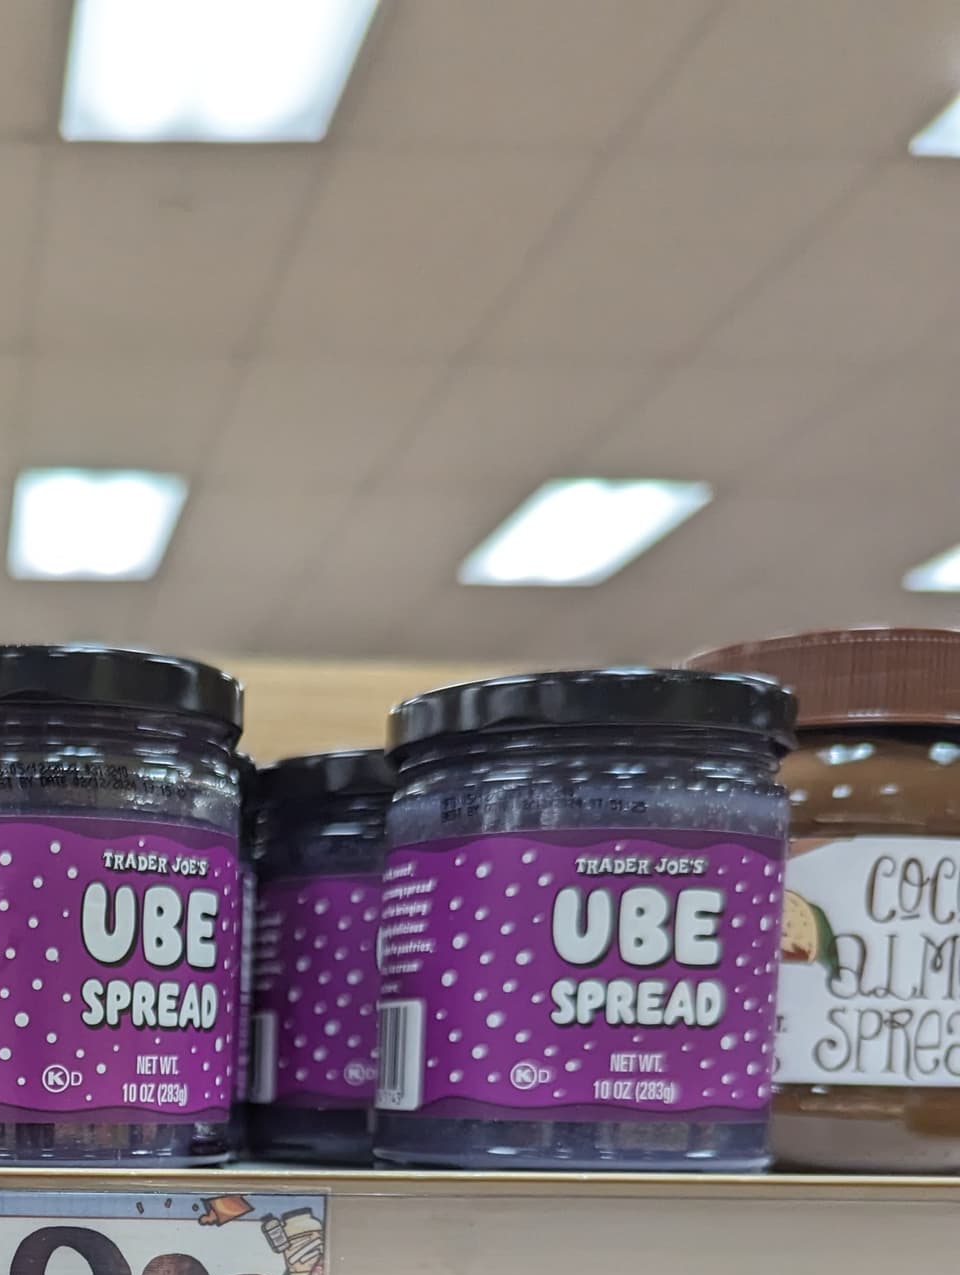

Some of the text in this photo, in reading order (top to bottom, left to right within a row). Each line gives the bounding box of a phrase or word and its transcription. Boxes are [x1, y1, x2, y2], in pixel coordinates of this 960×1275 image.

[103, 851, 209, 877] TRADER JOE'S
[575, 857, 707, 876] TRADER JOE'S
[81, 882, 219, 969] UBE
[552, 886, 725, 967] UBE
[81, 978, 218, 1030] SPREAD
[551, 979, 724, 1027] SPREAD
[136, 1054, 159, 1075] NET
[610, 1053, 636, 1073] NET
[122, 1083, 188, 1107] 10 OZ (283g)
[593, 1080, 677, 1104] 10 OZ (283g)
